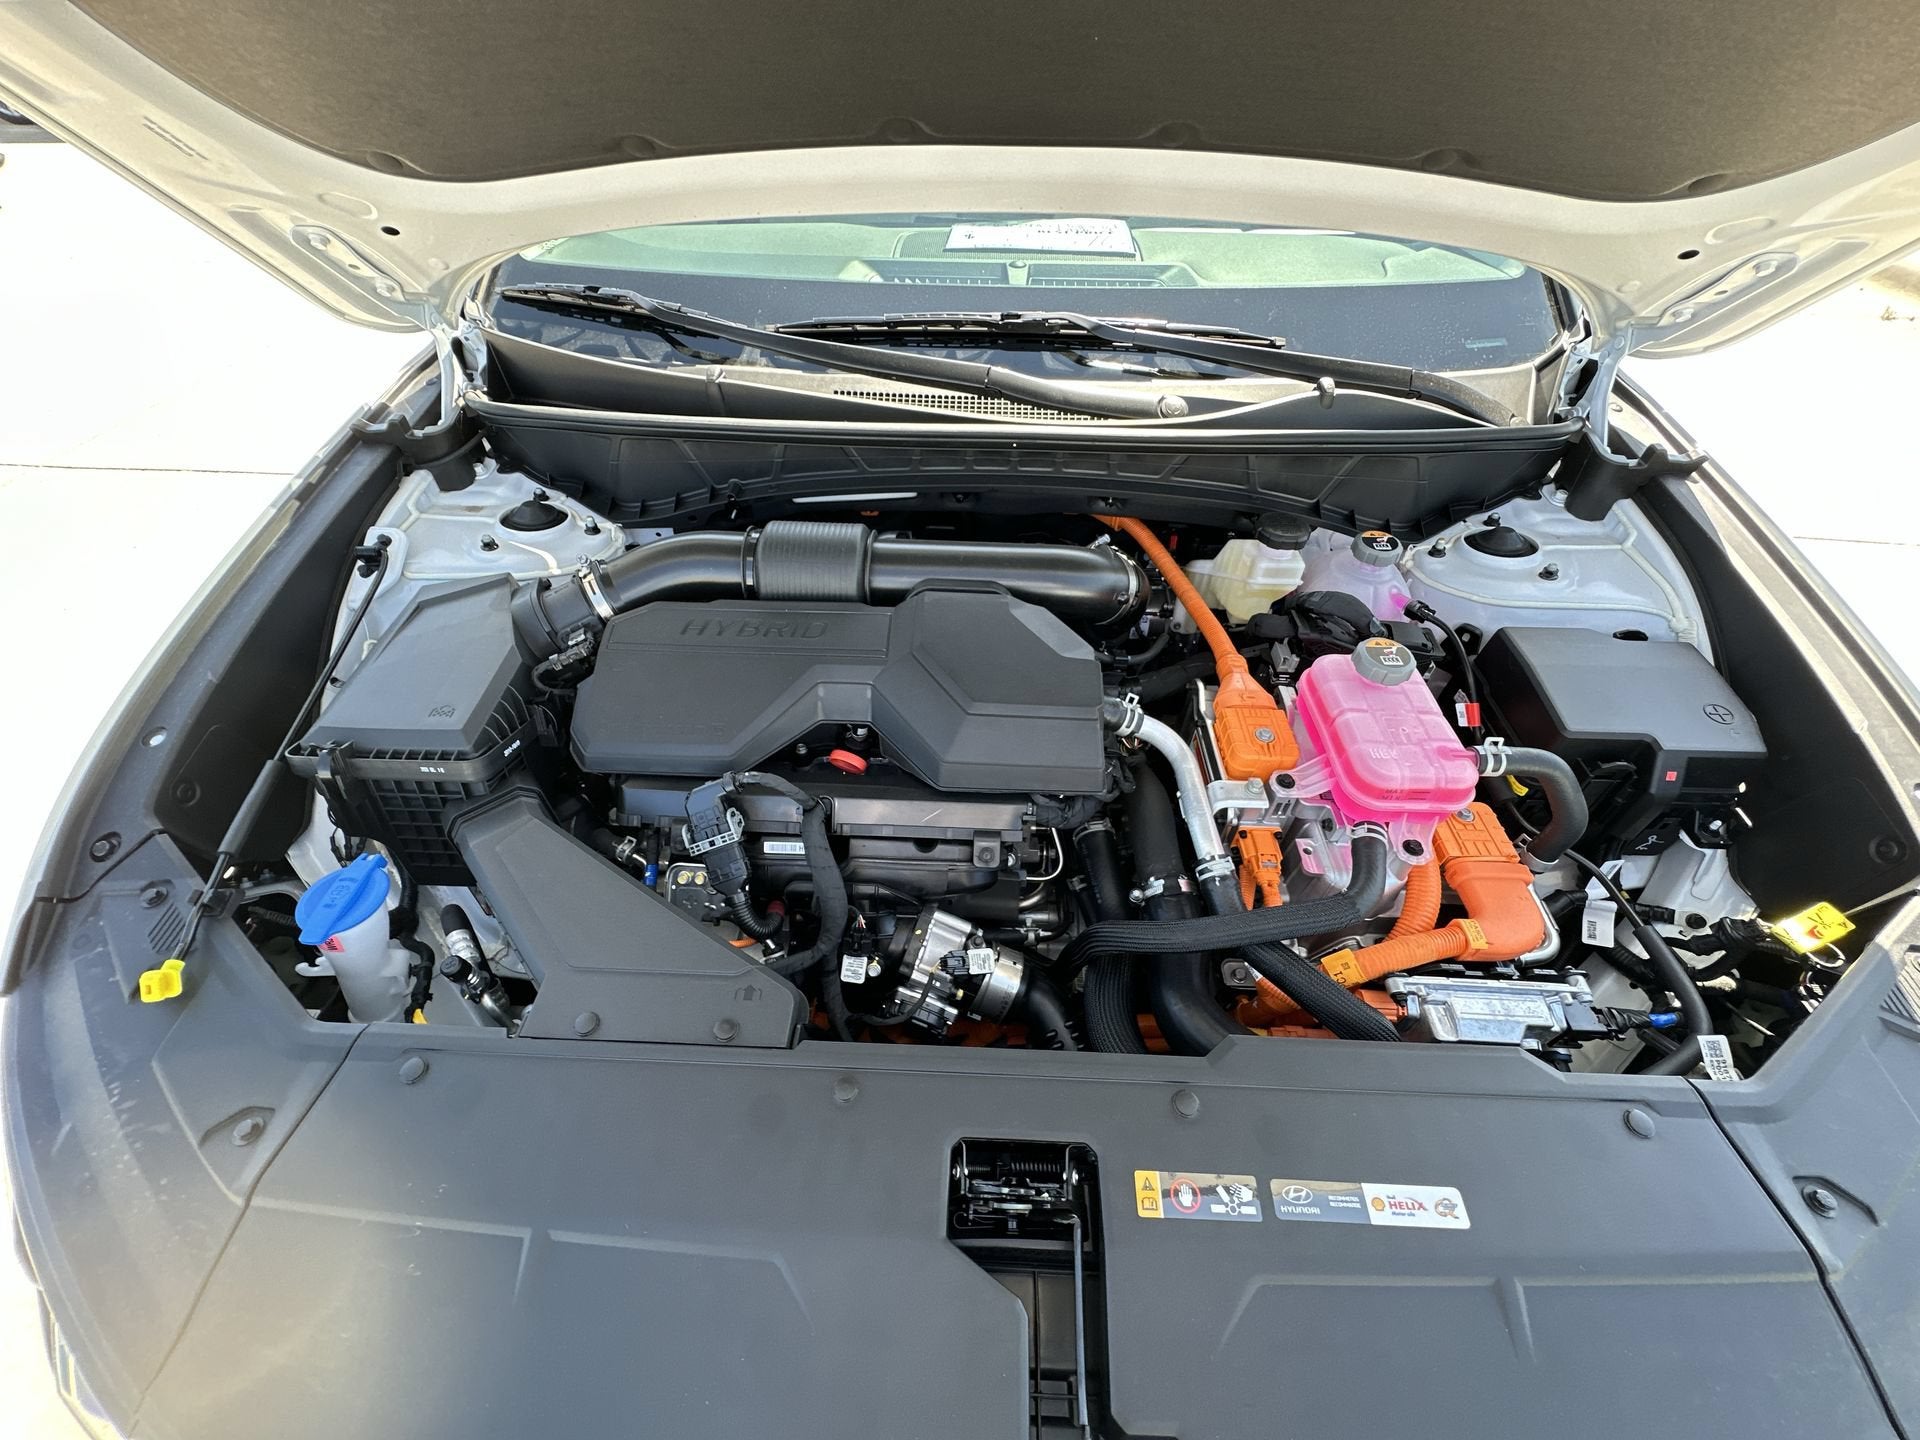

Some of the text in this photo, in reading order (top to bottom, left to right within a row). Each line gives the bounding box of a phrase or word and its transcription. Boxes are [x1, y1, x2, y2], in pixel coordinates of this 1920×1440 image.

[680, 618, 830, 639] HYBRID
[1280, 1205, 1321, 1215] HYUNDAI
[1388, 1199, 1428, 1211] HELIX
